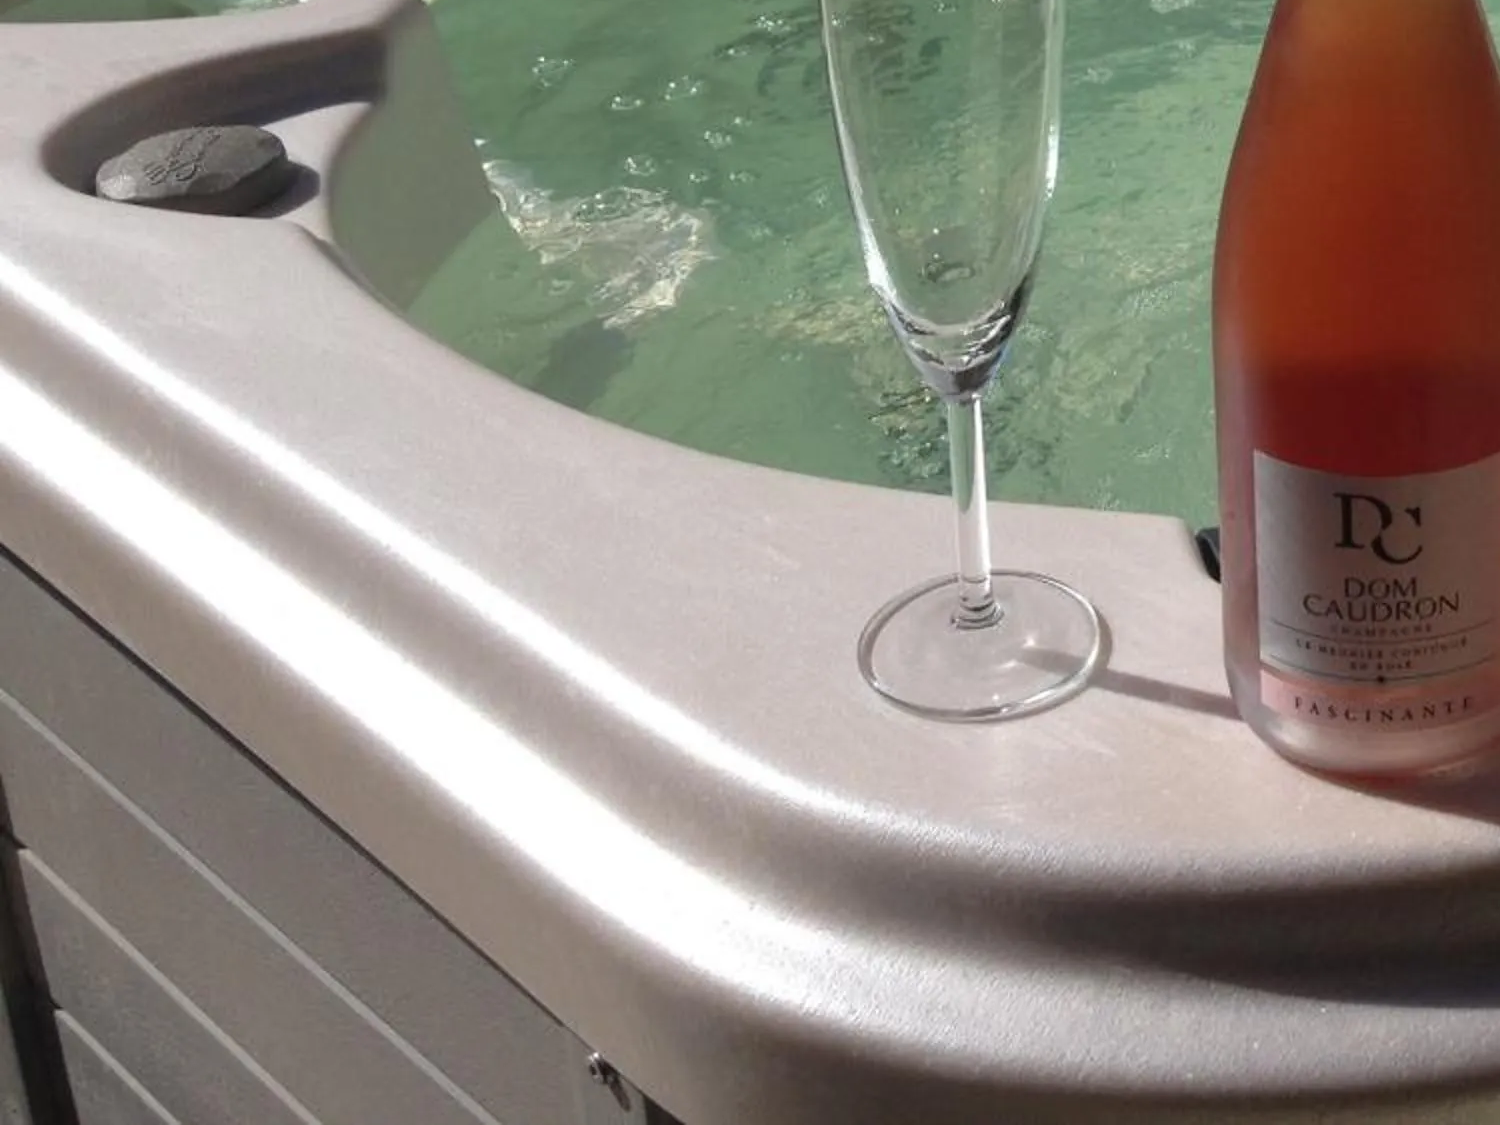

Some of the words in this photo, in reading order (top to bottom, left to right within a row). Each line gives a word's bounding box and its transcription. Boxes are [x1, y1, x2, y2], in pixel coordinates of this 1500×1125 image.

[1343, 576, 1418, 600] DOM
[1302, 592, 1460, 623] CAUDRON
[1294, 695, 1474, 723] FASCINANTE
